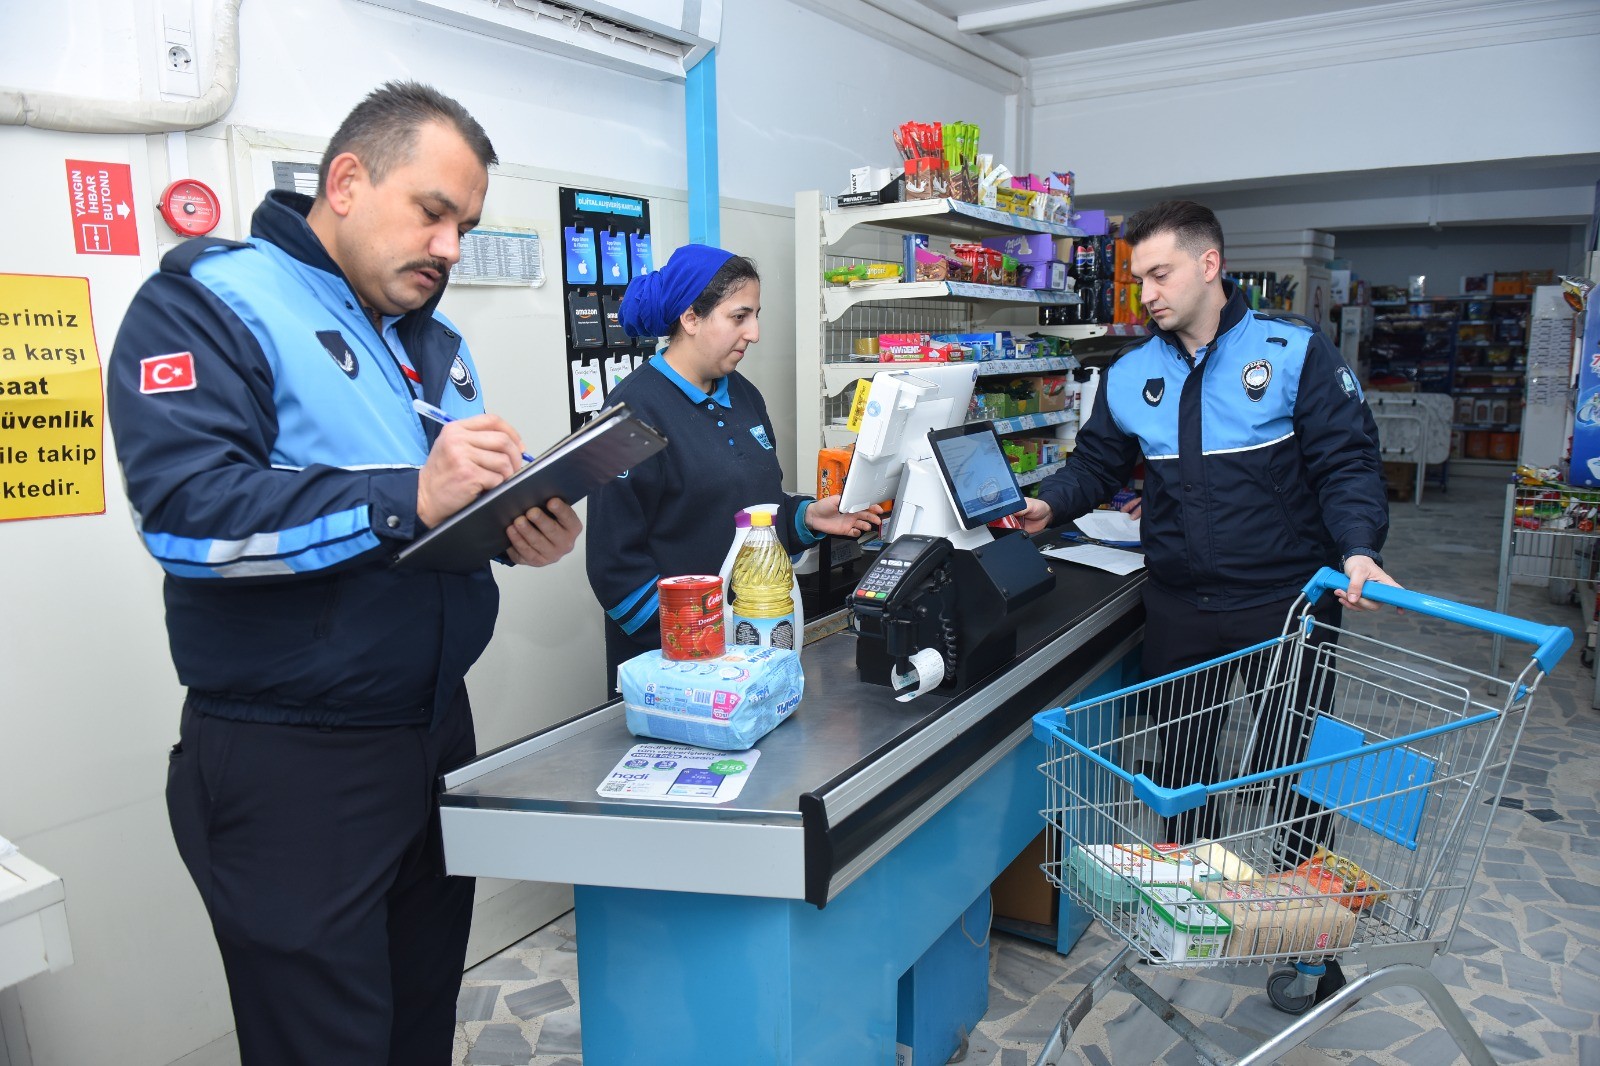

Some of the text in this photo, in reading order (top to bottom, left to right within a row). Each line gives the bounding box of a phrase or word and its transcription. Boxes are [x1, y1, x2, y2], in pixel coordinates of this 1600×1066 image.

[72, 170, 86, 217] YANGIN
[86, 175, 100, 214] İHBAR
[99, 170, 114, 220] BUTONU
[0, 309, 79, 328] erimiz
[2, 344, 86, 365] a karşı
[0, 377, 49, 395] saat
[1, 410, 95, 430] üvenlik
[0, 445, 97, 465] ile takip
[0, 479, 80, 499] ktedir.
[612, 772, 649, 780] hadi
